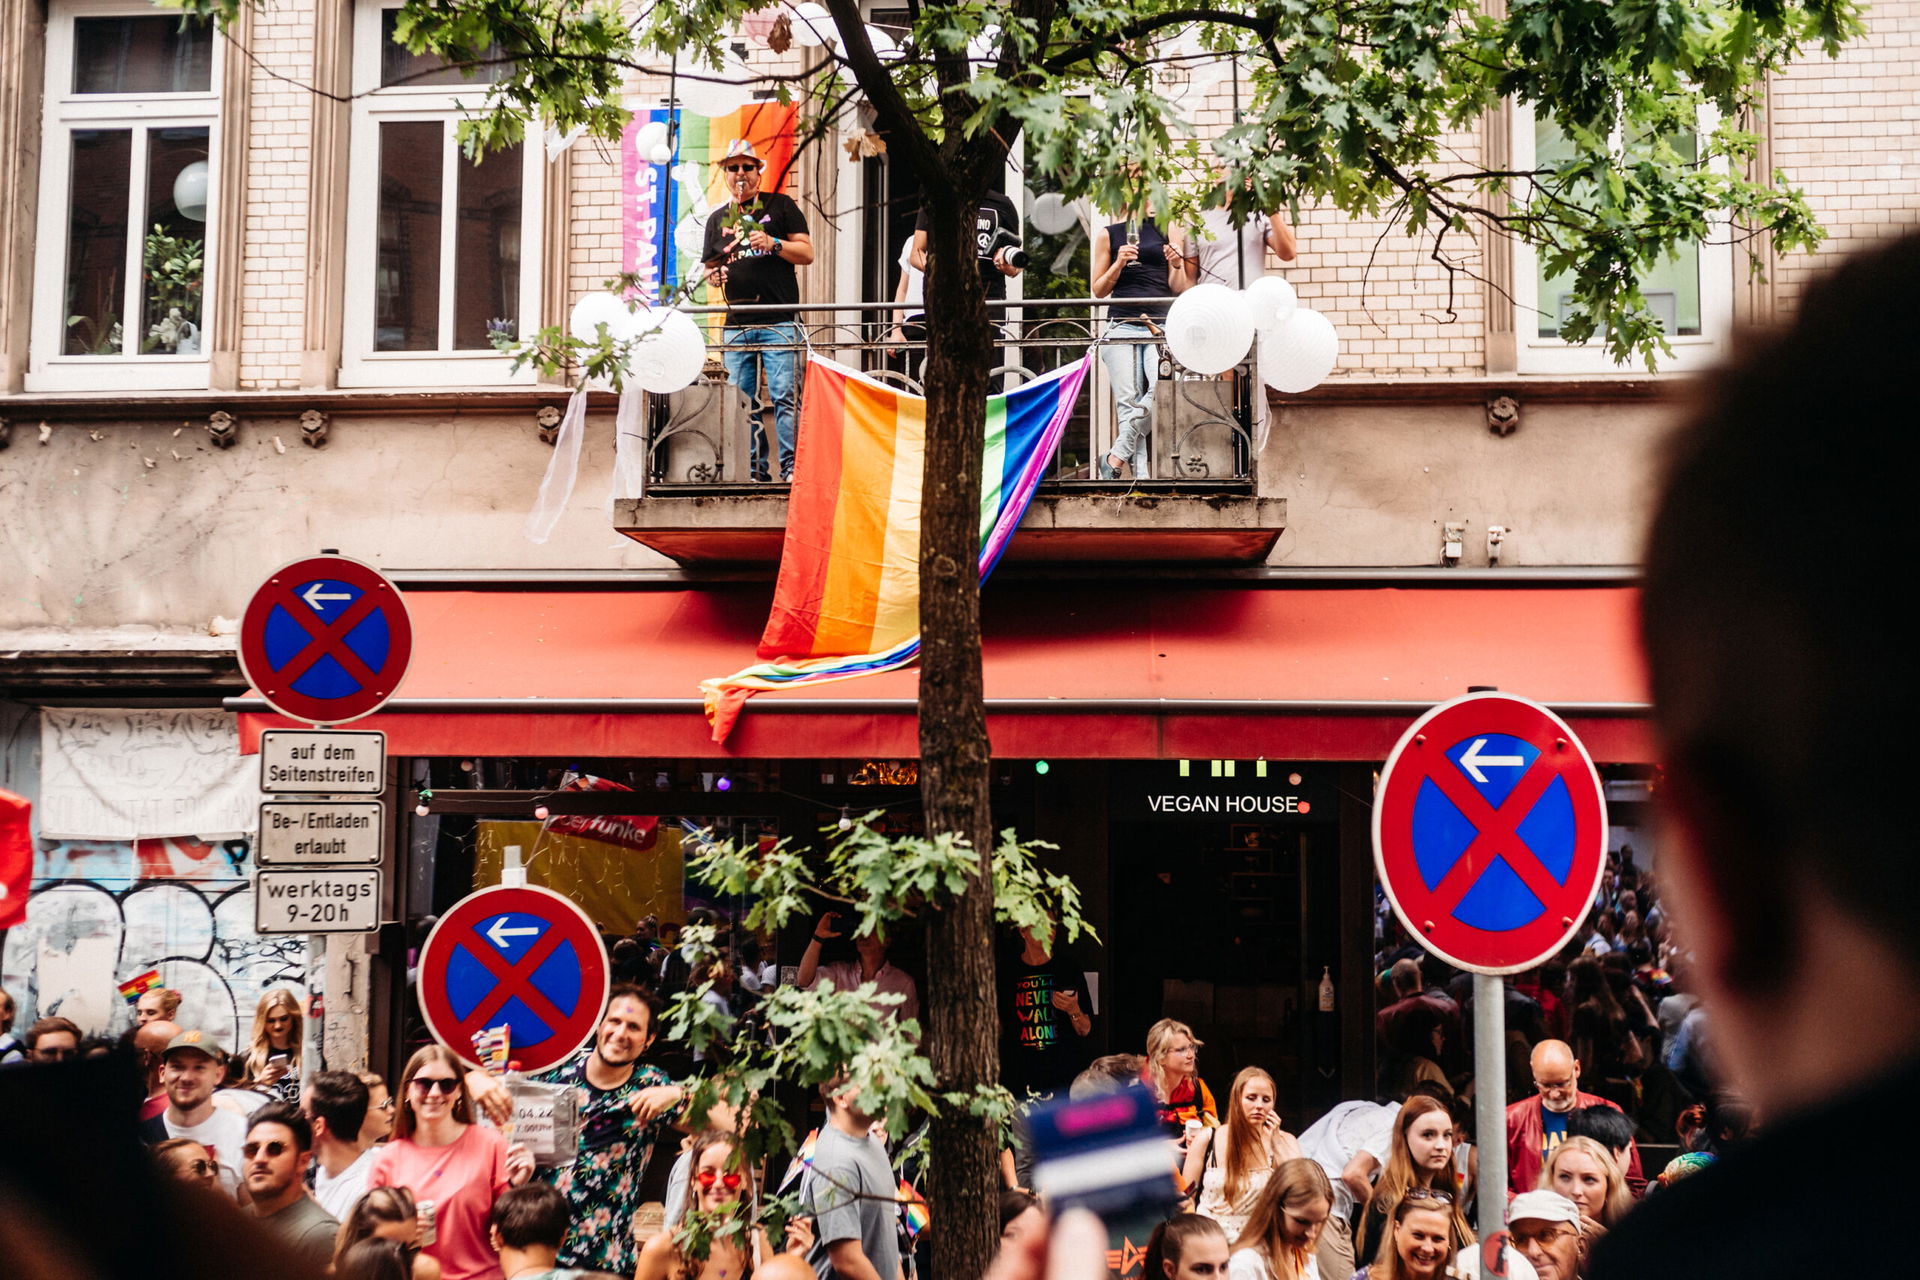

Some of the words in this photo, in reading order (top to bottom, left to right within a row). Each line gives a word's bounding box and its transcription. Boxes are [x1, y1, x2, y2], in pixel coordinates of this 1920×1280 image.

[634, 166, 658, 212] ST.
[633, 217, 660, 307] PAUL
[291, 744, 316, 760] auf
[324, 744, 355, 760] dem
[269, 766, 375, 783] Seitenstreifen
[1147, 795, 1220, 813] VEGAN
[1226, 795, 1298, 813] HOUSE
[272, 812, 369, 829] Be-/Entladen
[295, 838, 346, 855] erlaubt
[267, 880, 371, 902] werktags
[1020, 1024, 1058, 1041] ALONE
